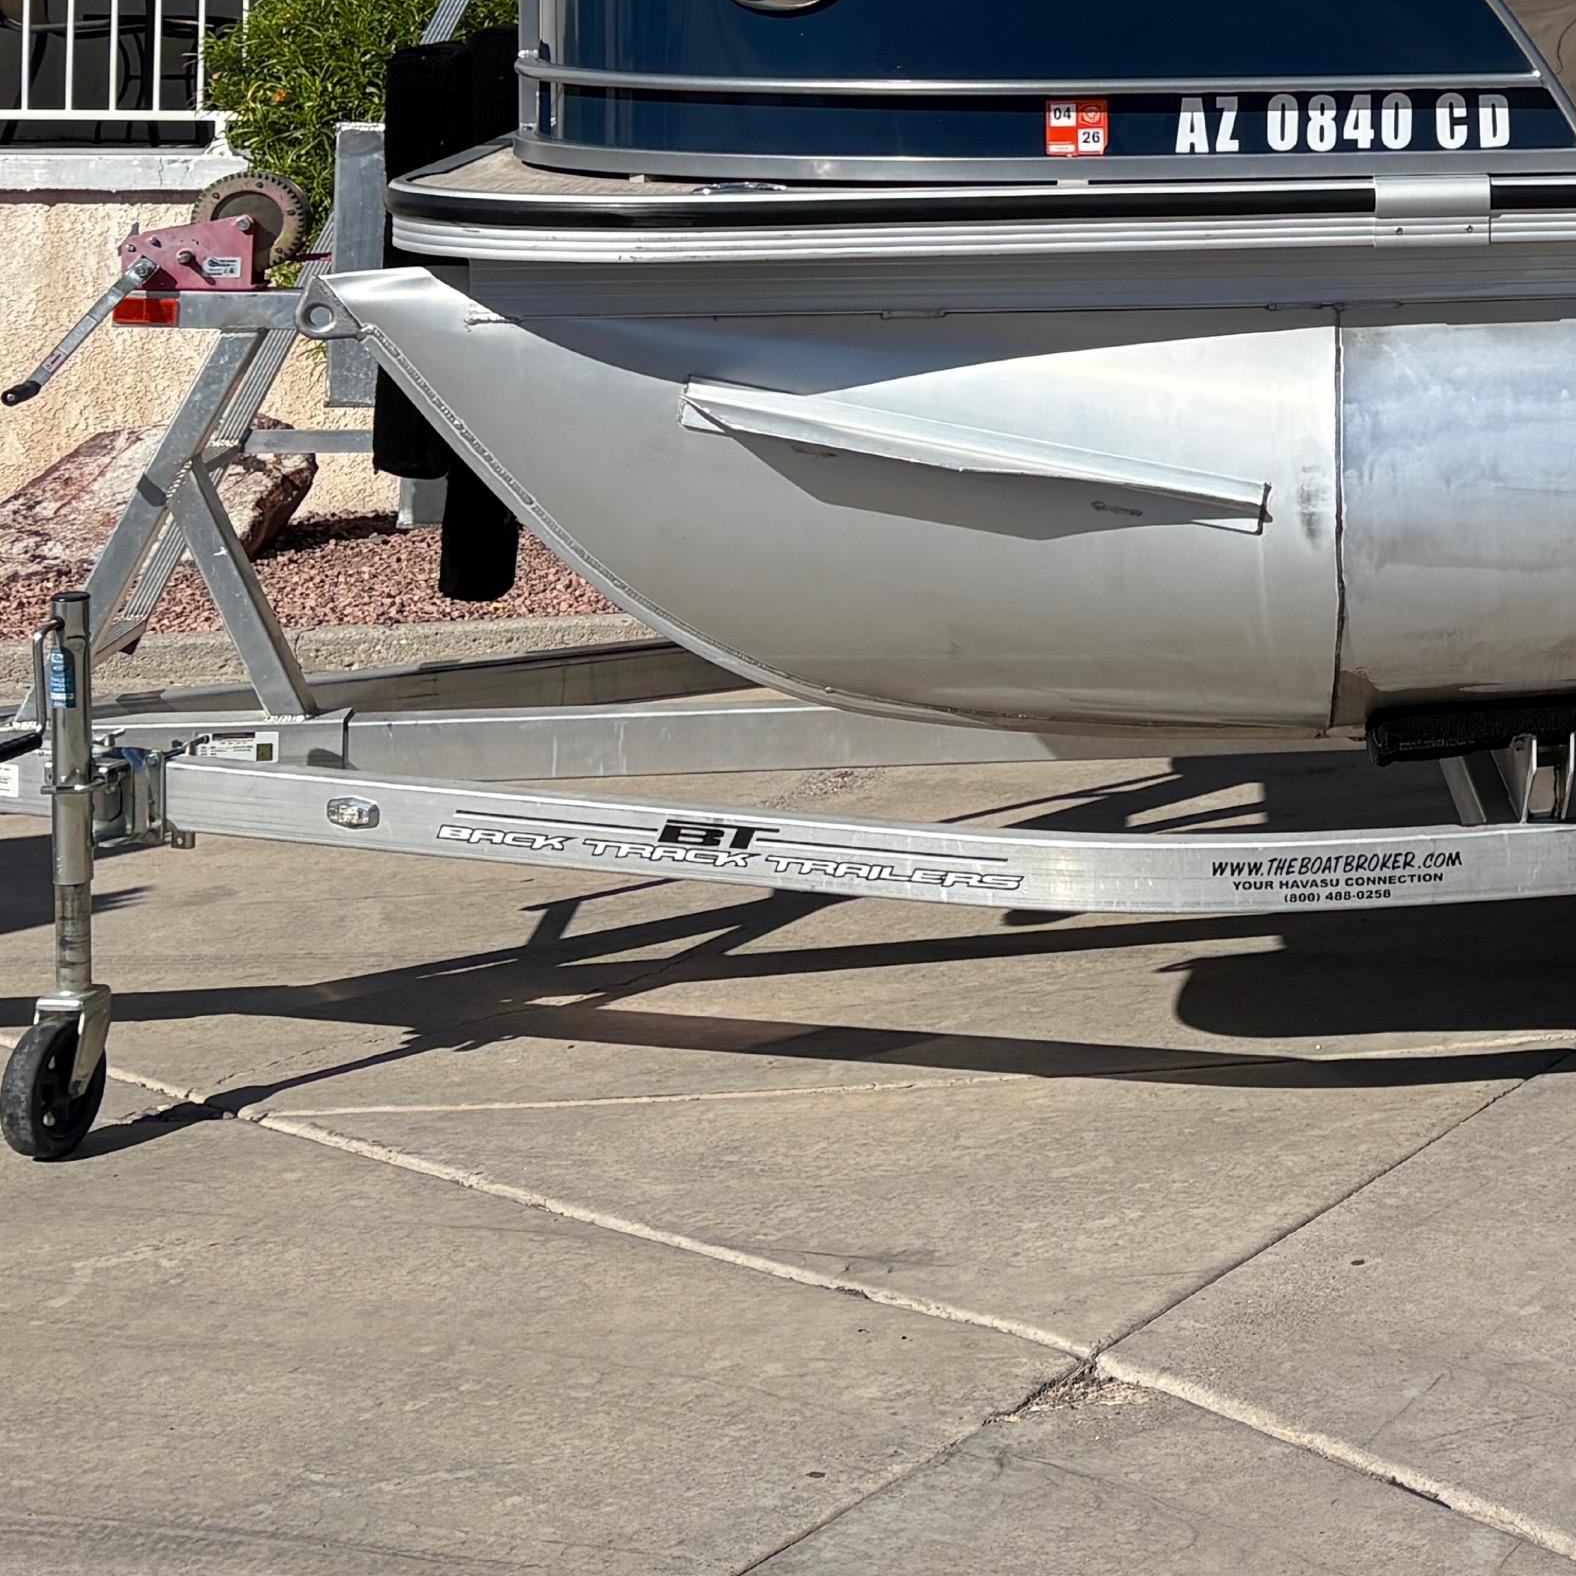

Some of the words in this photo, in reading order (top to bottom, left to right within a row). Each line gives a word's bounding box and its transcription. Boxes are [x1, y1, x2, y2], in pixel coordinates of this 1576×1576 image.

[1053, 107, 1072, 120] 04
[1175, 96, 1239, 153] AZ
[1266, 92, 1413, 152] 0840
[1435, 92, 1510, 149] CD
[1082, 131, 1100, 144] 26
[437, 824, 576, 851] BACK
[583, 838, 761, 868] TRACK
[765, 854, 1025, 891] TRAILERS
[1211, 851, 1463, 877] WWW.THEBOATBROKER.COM
[1233, 880, 1275, 891] YOUR
[1279, 877, 1340, 890] HAVASU
[1345, 872, 1444, 887] CONNECTION
[1284, 892, 1321, 904] (800)
